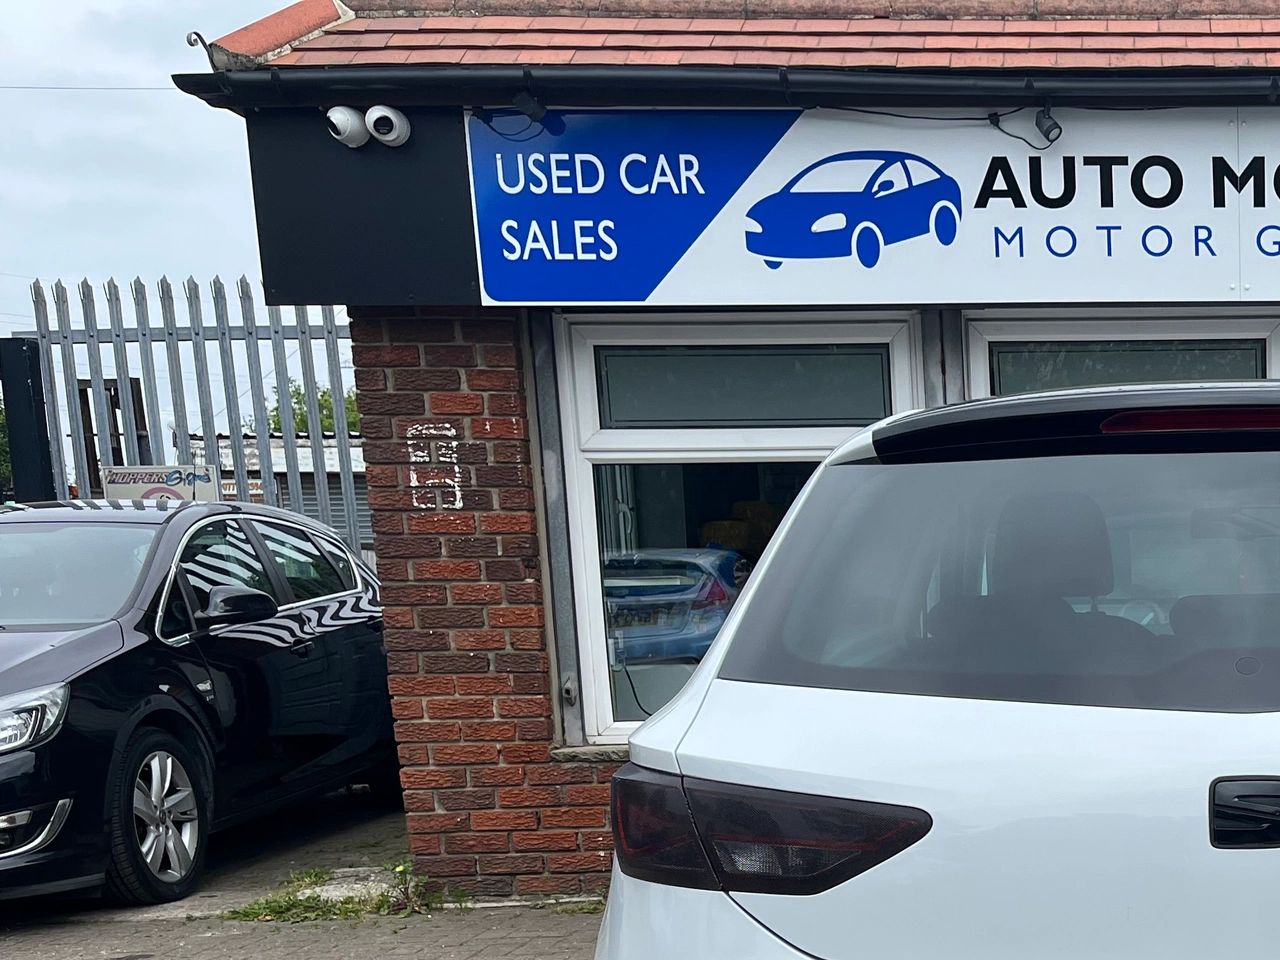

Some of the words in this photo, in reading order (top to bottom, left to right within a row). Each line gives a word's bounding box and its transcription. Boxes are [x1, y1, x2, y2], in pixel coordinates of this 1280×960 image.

[495, 152, 605, 195] USED
[619, 152, 706, 195] CAR
[973, 155, 1184, 209] AUTO
[500, 219, 619, 262] SALES
[994, 225, 1218, 258] MOTOR
